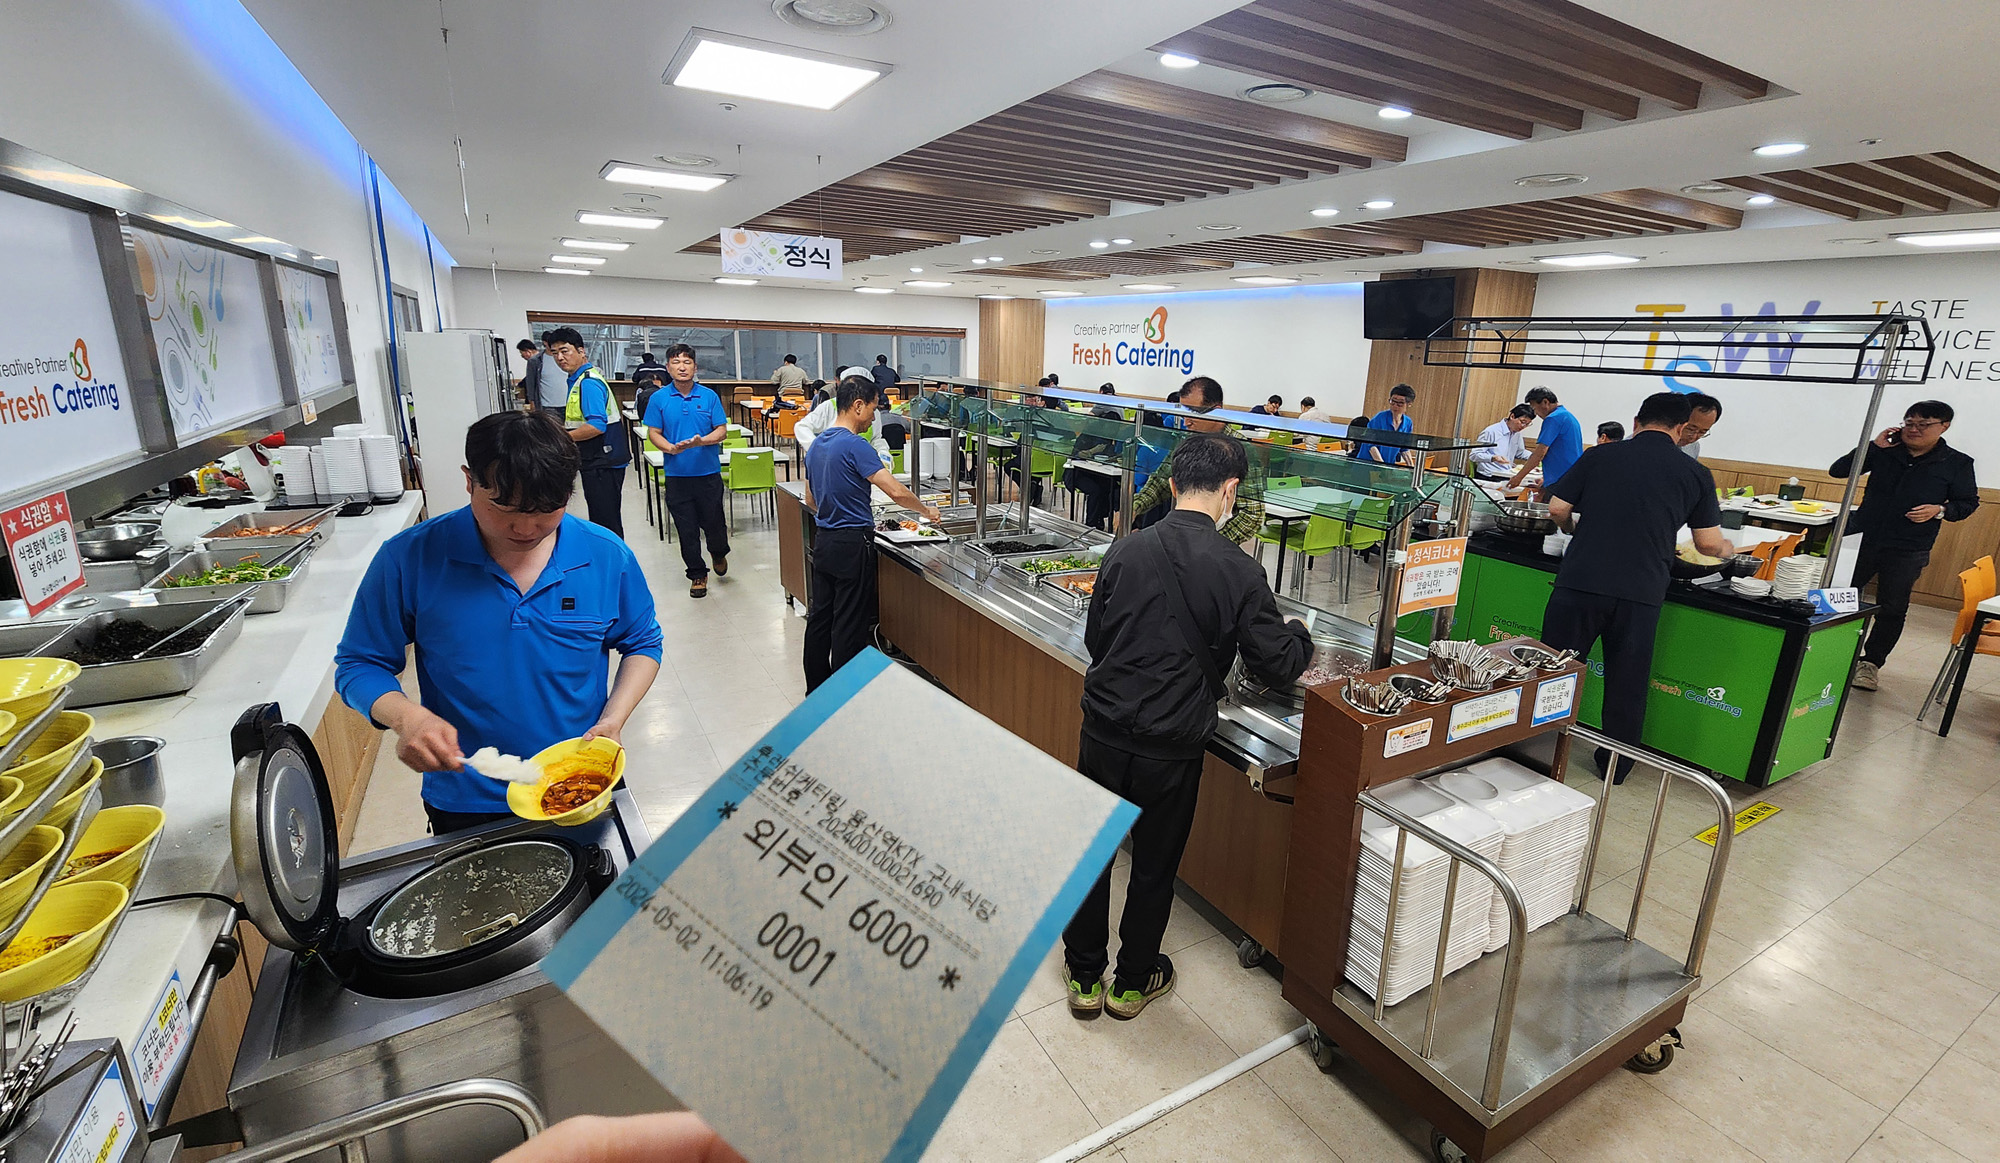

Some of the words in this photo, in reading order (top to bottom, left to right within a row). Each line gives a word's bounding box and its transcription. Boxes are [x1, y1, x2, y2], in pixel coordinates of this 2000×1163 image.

[784, 244, 831, 270] 정식
[1871, 299, 1969, 319] TASTE
[1074, 323, 1107, 336] Creative
[1109, 322, 1140, 336] Partner
[0, 359, 34, 378] reative
[35, 357, 68, 374] Partner
[1072, 343, 1111, 366] Fresh
[1115, 341, 1195, 375] Catering
[53, 378, 119, 414] Catering
[20, 501, 53, 530] 식권함
[18, 537, 48, 561] 식권함에
[48, 527, 68, 547] 식권을
[1413, 544, 1452, 564] 정식코너
[29, 558, 45, 578] 넣어
[46, 548, 67, 569] 주세요!
[1830, 592, 1845, 603] PLUS
[1492, 615, 1527, 631] Creative
[1651, 678, 1682, 697] Fresh
[1685, 690, 1742, 718] Catering
[742, 756, 804, 808] 주문번호
[848, 809, 925, 868] 용산역KTX
[928, 863, 998, 922] 구내식당
[743, 819, 848, 909] 외부인
[849, 898, 930, 971] 6000
[616, 875, 702, 951] 2024-05-02
[701, 944, 774, 1011] 11:06:19
[757, 911, 837, 988] 0001
[142, 1027, 160, 1061] 코너는
[159, 988, 178, 1026] 1코너만
[142, 1058, 154, 1083] 이용
[83, 1105, 99, 1136] 이용
